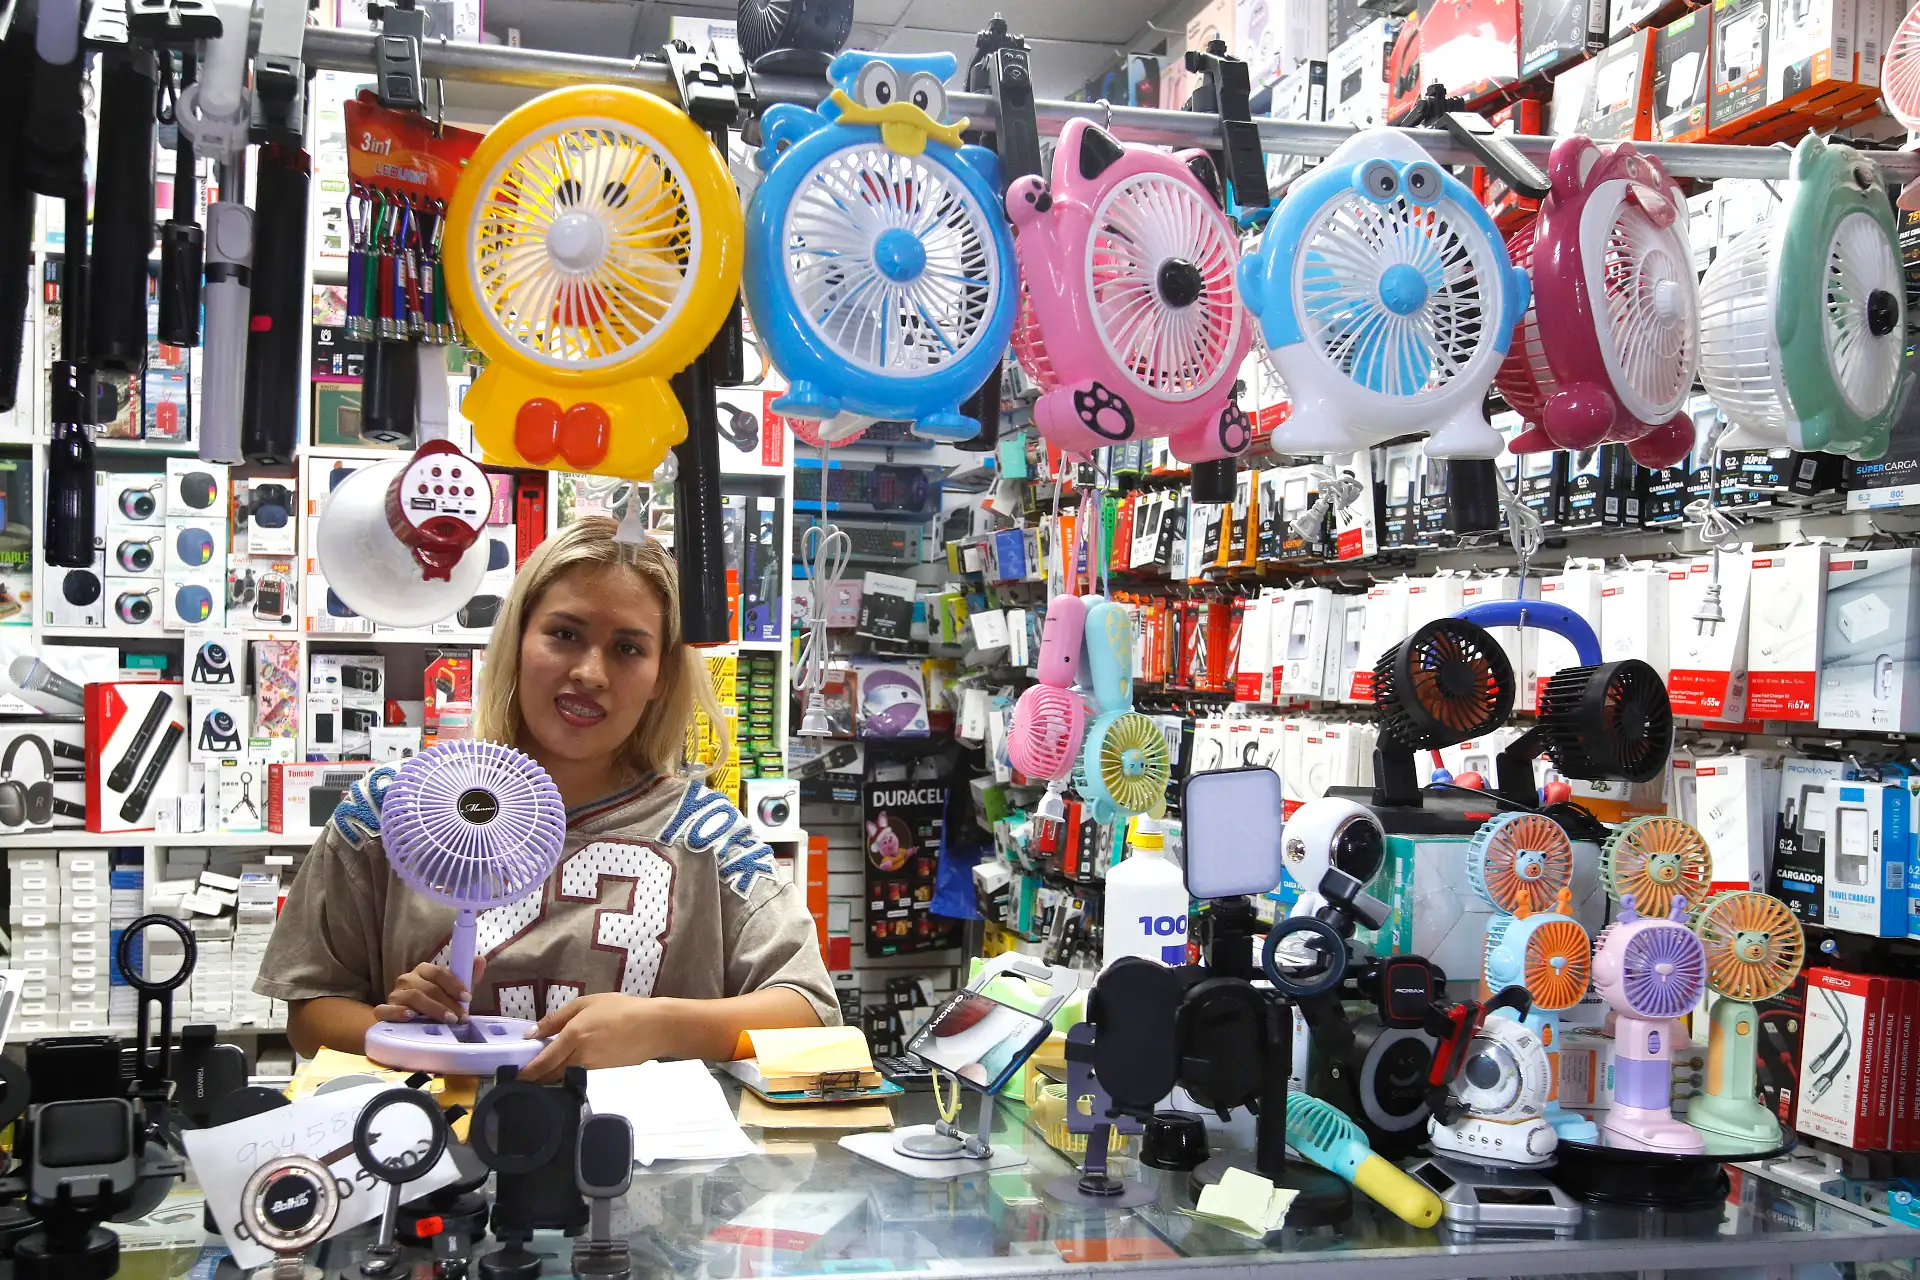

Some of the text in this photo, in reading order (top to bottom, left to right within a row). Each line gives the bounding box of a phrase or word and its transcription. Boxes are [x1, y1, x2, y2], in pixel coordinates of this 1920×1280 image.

[361, 131, 392, 156] 3in1
[1787, 765, 1833, 776] ROMAX
[872, 788, 949, 807] DURACEL
[1776, 868, 1824, 884] CARGADOR
[1828, 890, 1876, 905] TRAVEL CHARGER
[1821, 975, 1851, 988] REDD
[1867, 1012, 1876, 1036] CABLE
[1886, 1012, 1894, 1036] CABLE
[1864, 1037, 1874, 1074] CHARGING
[1883, 1037, 1892, 1074] CHARGING
[1861, 1093, 1869, 1117] SUPER
[1879, 1093, 1887, 1117] SUPER
[1812, 1110, 1834, 1122] CHARGING
[1834, 1117, 1848, 1126] CABLE
